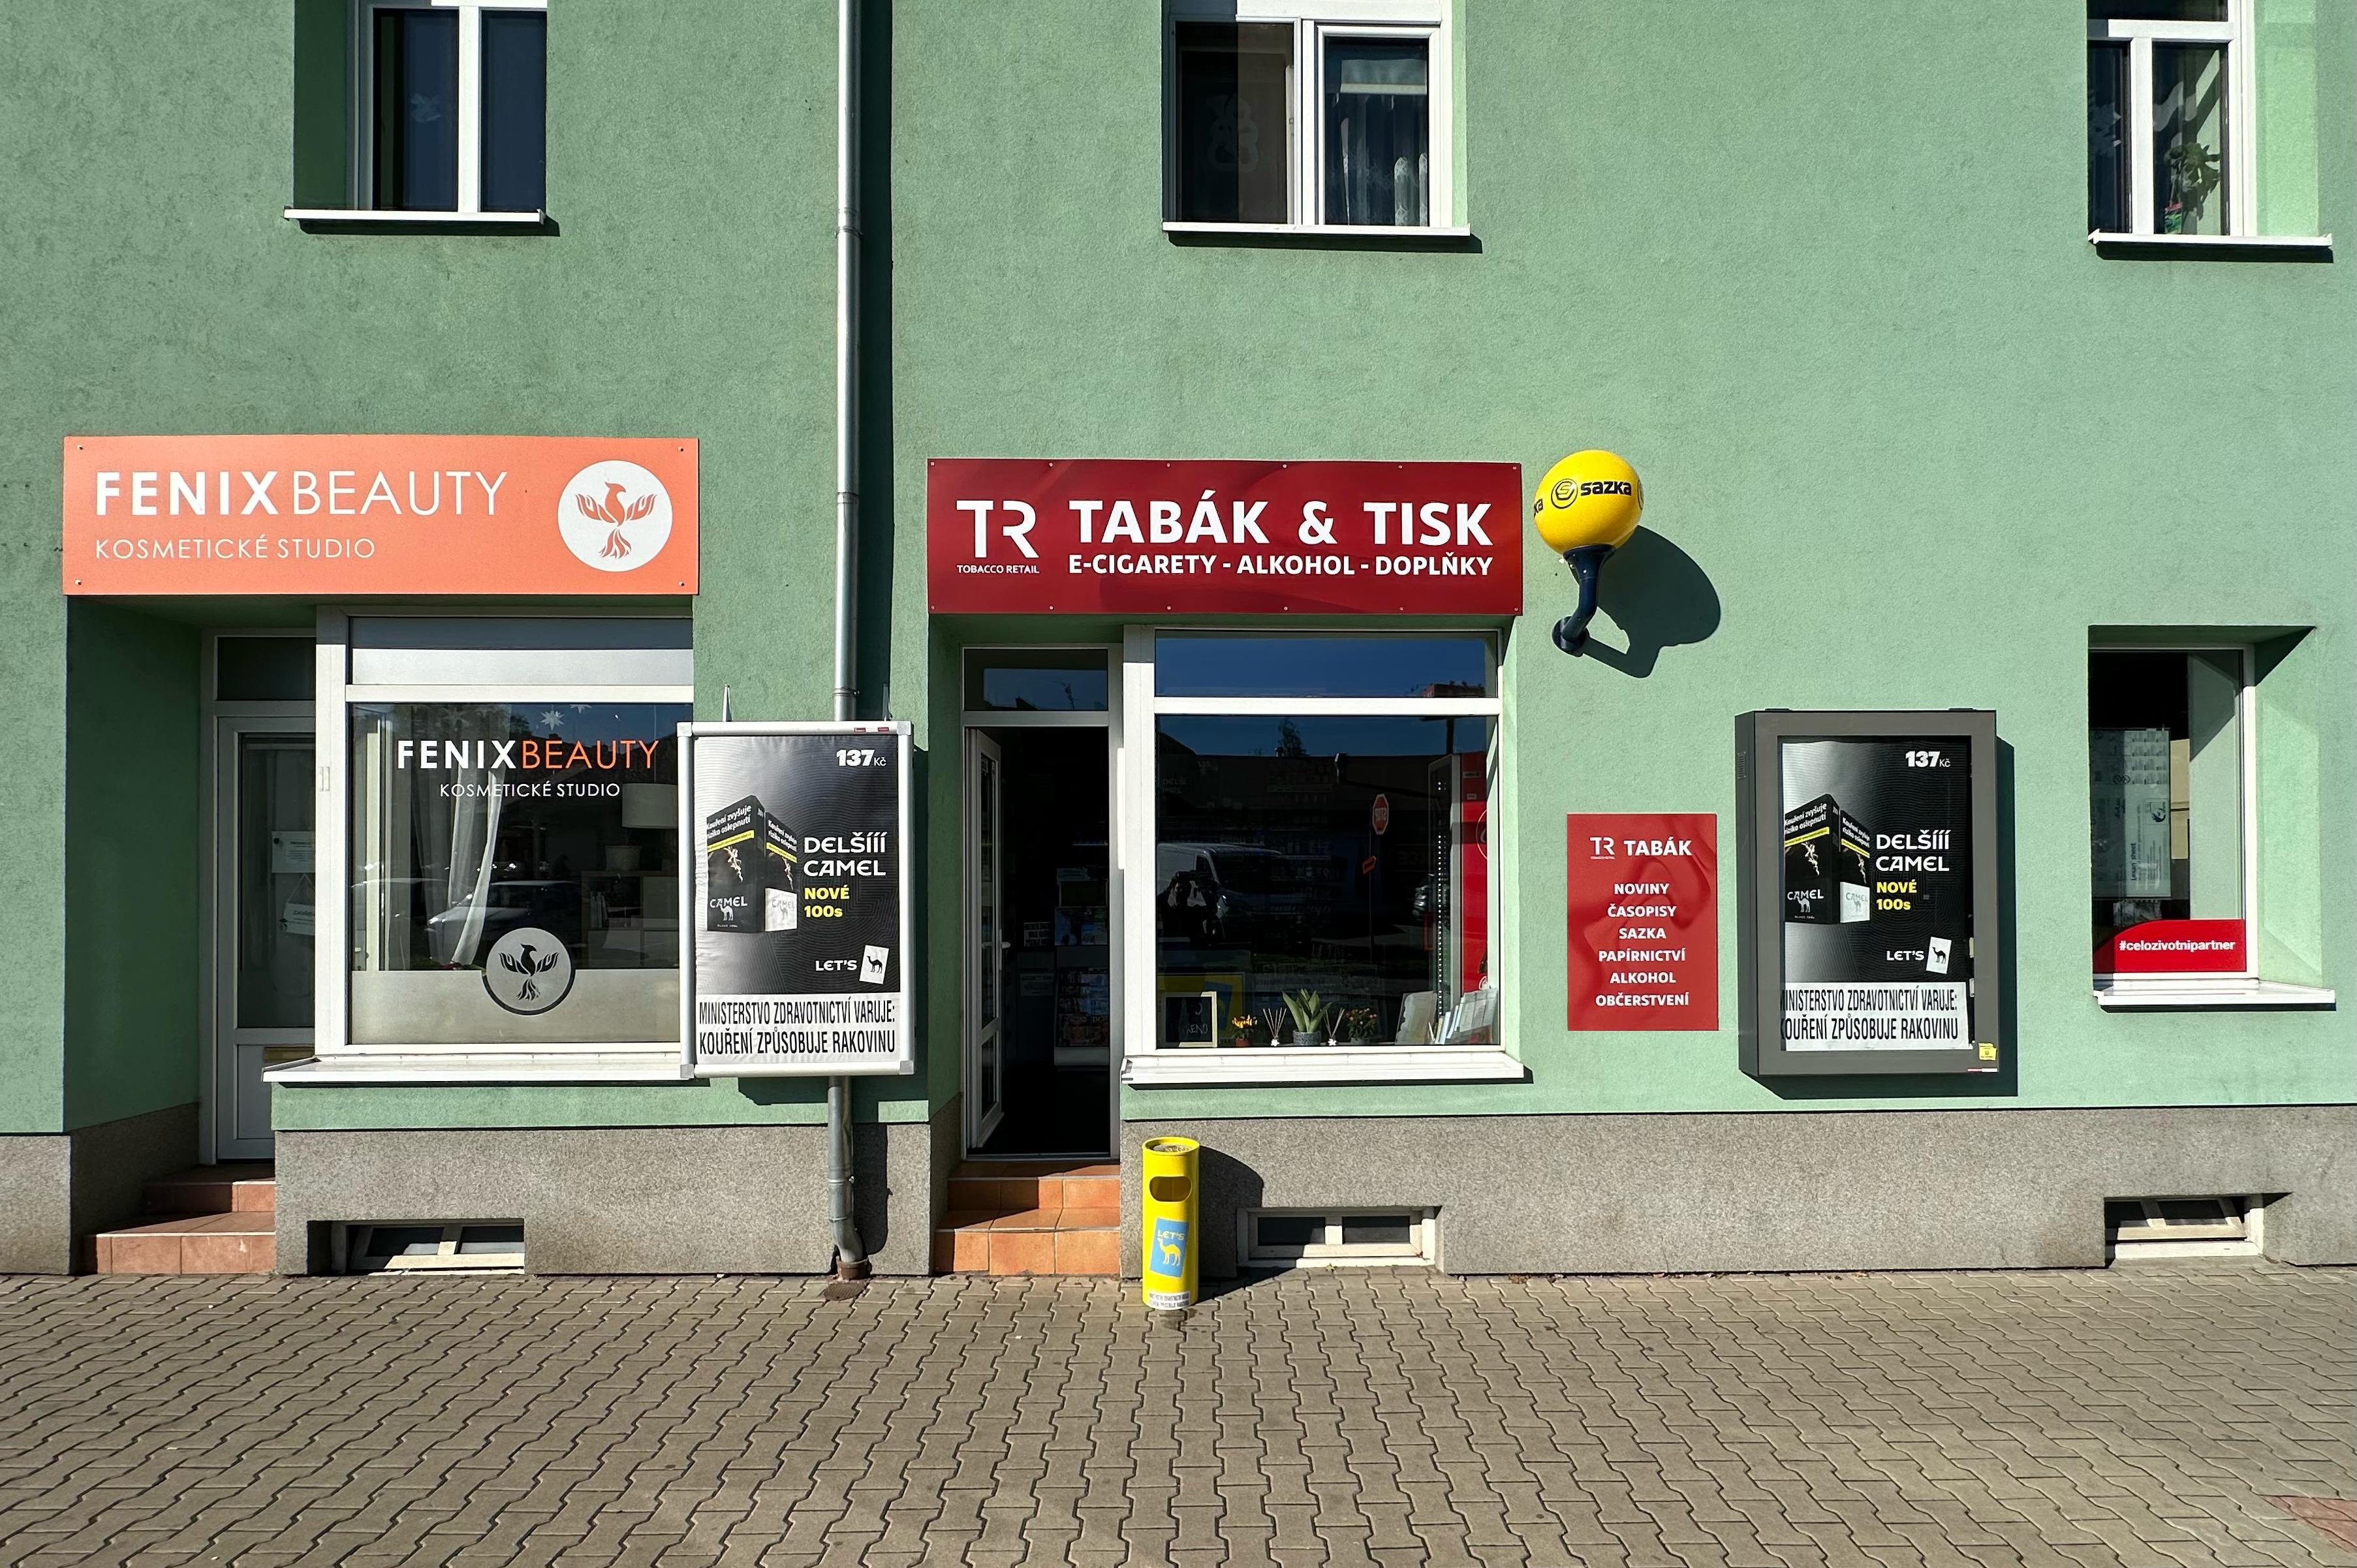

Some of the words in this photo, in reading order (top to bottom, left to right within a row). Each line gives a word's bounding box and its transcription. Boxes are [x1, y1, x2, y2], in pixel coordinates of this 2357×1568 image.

[1069, 490, 1269, 543] TABÁK
[1299, 501, 1337, 544] &
[1364, 503, 1493, 545] TISK
[957, 501, 1038, 557] TR
[97, 534, 267, 559] KOSMETICKÉ
[277, 539, 374, 558] STUDIO
[957, 565, 1003, 573] TOBACCO
[1070, 555, 1217, 573] E-CIGARETY
[1237, 556, 1354, 574] ALKOHOL
[1376, 552, 1493, 575] DOPLŇKY
[440, 780, 551, 797] KOSMETICKÉ
[557, 783, 619, 796] STUDIO
[805, 832, 887, 853] DELŠÍÍÍ
[1590, 838, 1615, 855] TR
[1624, 837, 1692, 856] TABÁK
[1877, 830, 1951, 849] DELŠÍÍÍ
[804, 860, 886, 876] CAMEL
[1876, 856, 1949, 871] CAMEL
[805, 885, 849, 900] NOVÉ
[1615, 883, 1669, 894] NOVINY
[1877, 879, 1916, 893] NOVÉ
[709, 896, 749, 909] CAMEL
[1786, 889, 1825, 902] CAMEL
[804, 905, 843, 917] 100s
[1608, 903, 1676, 917] ČASOPISY
[1877, 899, 1911, 910] 100s
[1619, 928, 1666, 939] SAZKA
[2119, 940, 2236, 952] #celozivotnipartner
[1599, 948, 1685, 962] PAPÍRNICTVÍ
[1610, 972, 1676, 983] ALKOHOL
[1596, 992, 1689, 1006] OBČERSTVENÍ
[1848, 986, 1919, 1011] ZDRAVOTNICTVÍ
[1922, 990, 1957, 1011] VARUJE:
[700, 1002, 770, 1024] MINISTERSTVO
[773, 997, 851, 1024] ZDRAVOTNICTVÍ
[854, 1000, 894, 1023] VARUJE:
[1832, 1013, 1896, 1039] ZPŮSOBUJE
[1901, 1018, 1958, 1039] RAKOVINU
[700, 1027, 753, 1054] KOUŘENÍ
[757, 1027, 828, 1054] ZPŮSOBUJE
[833, 1030, 894, 1052] RAKOVINU
